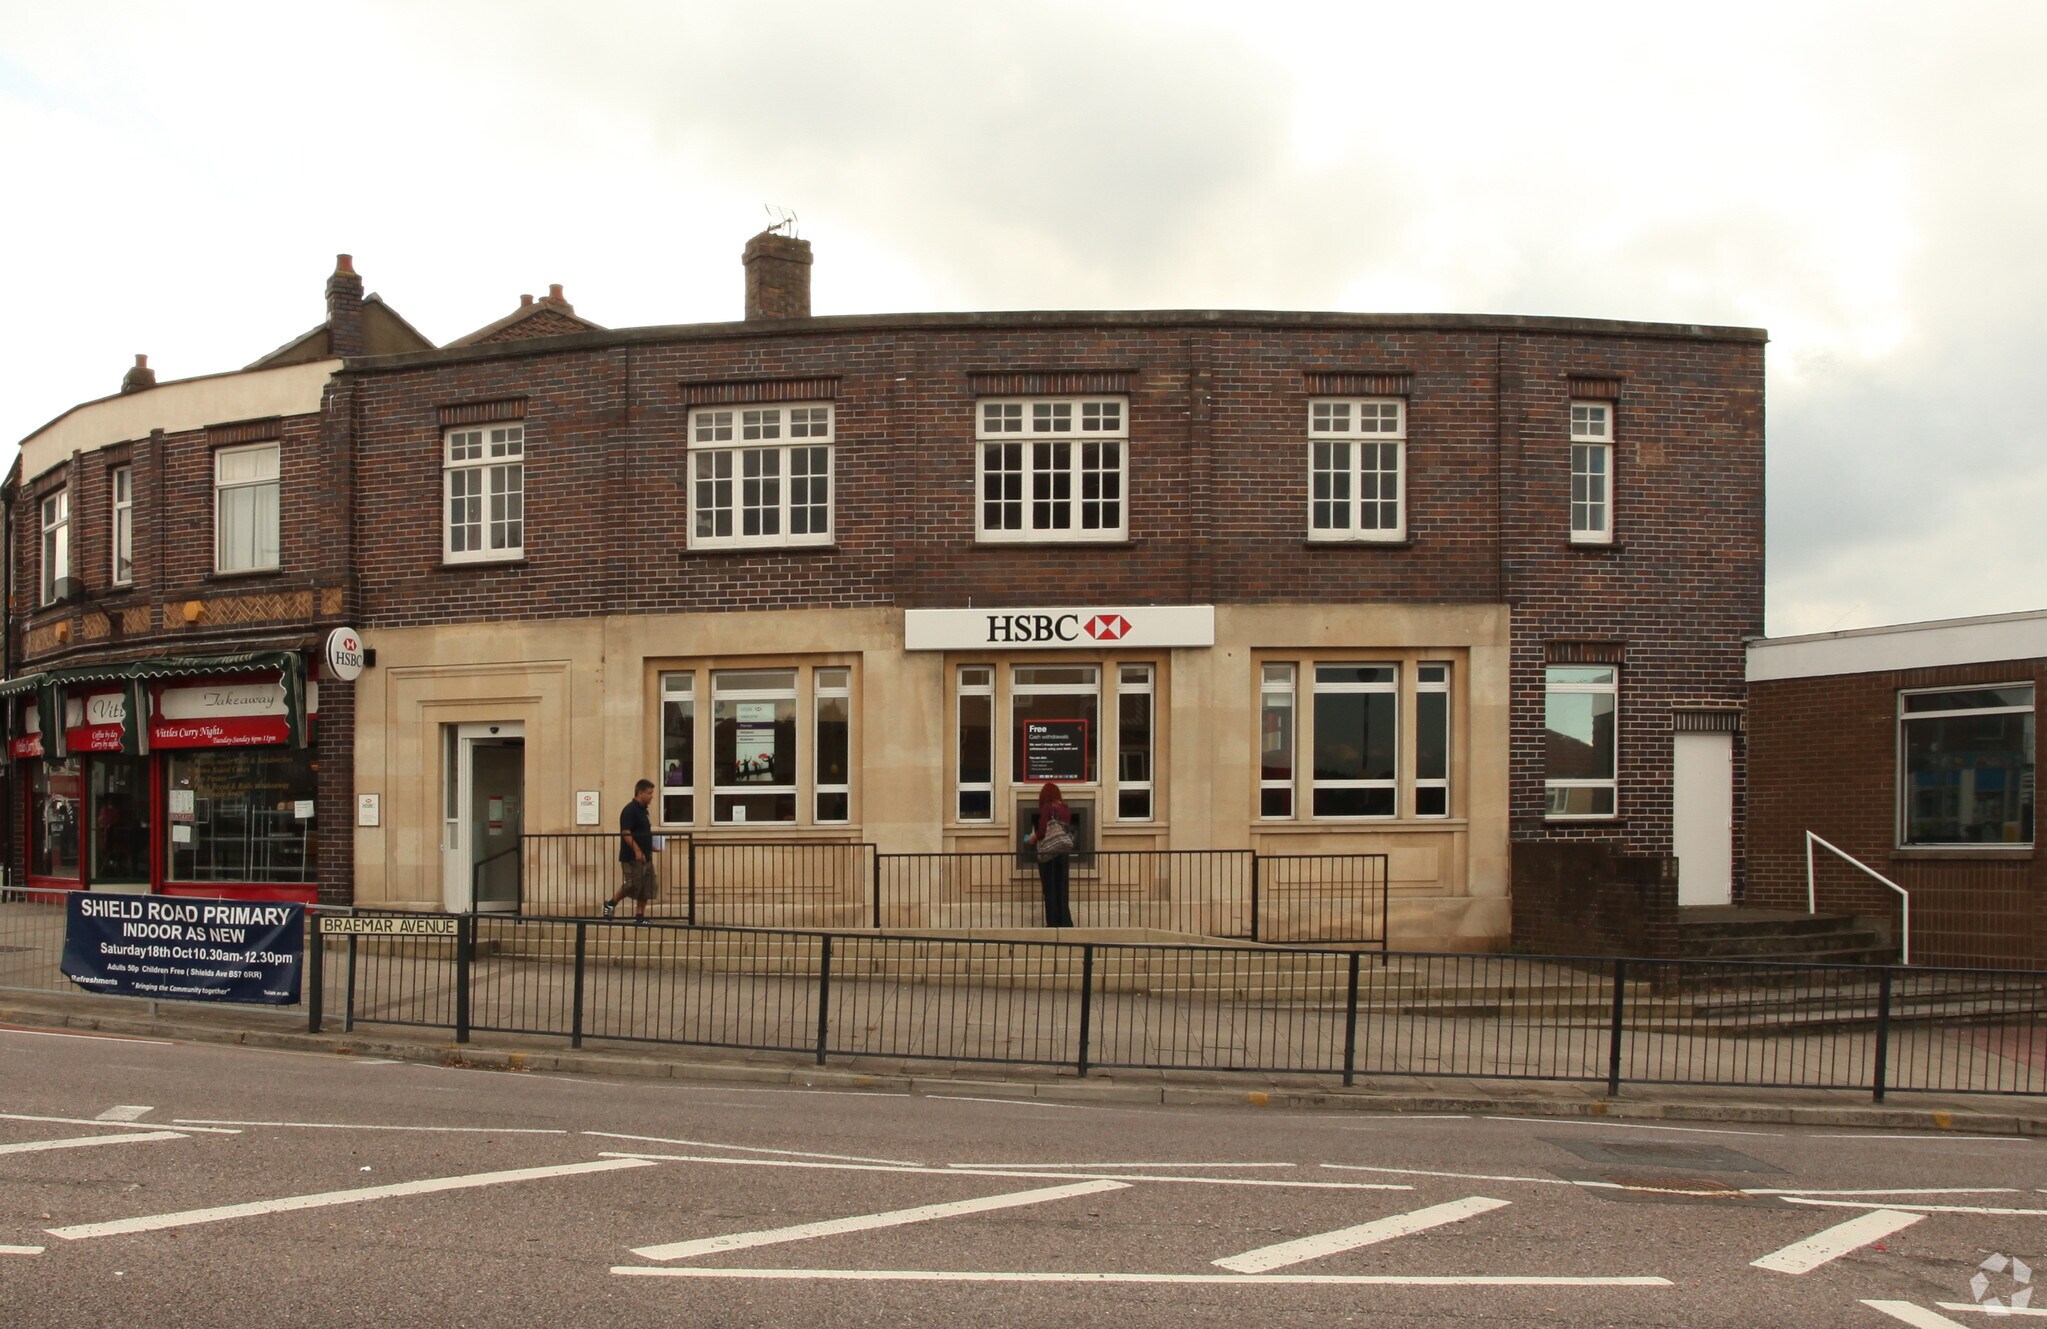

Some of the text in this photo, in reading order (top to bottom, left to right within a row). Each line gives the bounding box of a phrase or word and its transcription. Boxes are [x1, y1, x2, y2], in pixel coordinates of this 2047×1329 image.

[986, 614, 1079, 642] HSBC
[336, 651, 362, 668] HSBC
[203, 691, 275, 709] Takeaway
[155, 725, 223, 739] Vittles Curry Nights
[1029, 725, 1047, 733] Free
[81, 899, 290, 925] SHIELD ROAD PRIMARY
[123, 922, 245, 943] INDOOR AS NEW
[324, 918, 454, 933] BRAEMAR AVENUE
[100, 942, 147, 959] Saturday
[147, 945, 170, 958] 18th
[172, 946, 193, 959] Oct
[107, 963, 126, 971] Adults
[127, 964, 139, 973] 50p
[142, 965, 169, 974] Children
[170, 967, 185, 975] Free
[190, 968, 214, 977] Shields
[215, 969, 227, 977] Ave
[228, 970, 242, 978] BS7
[71, 974, 118, 986] Refreshments
[158, 984, 168, 992] the
[169, 985, 201, 994] Community
